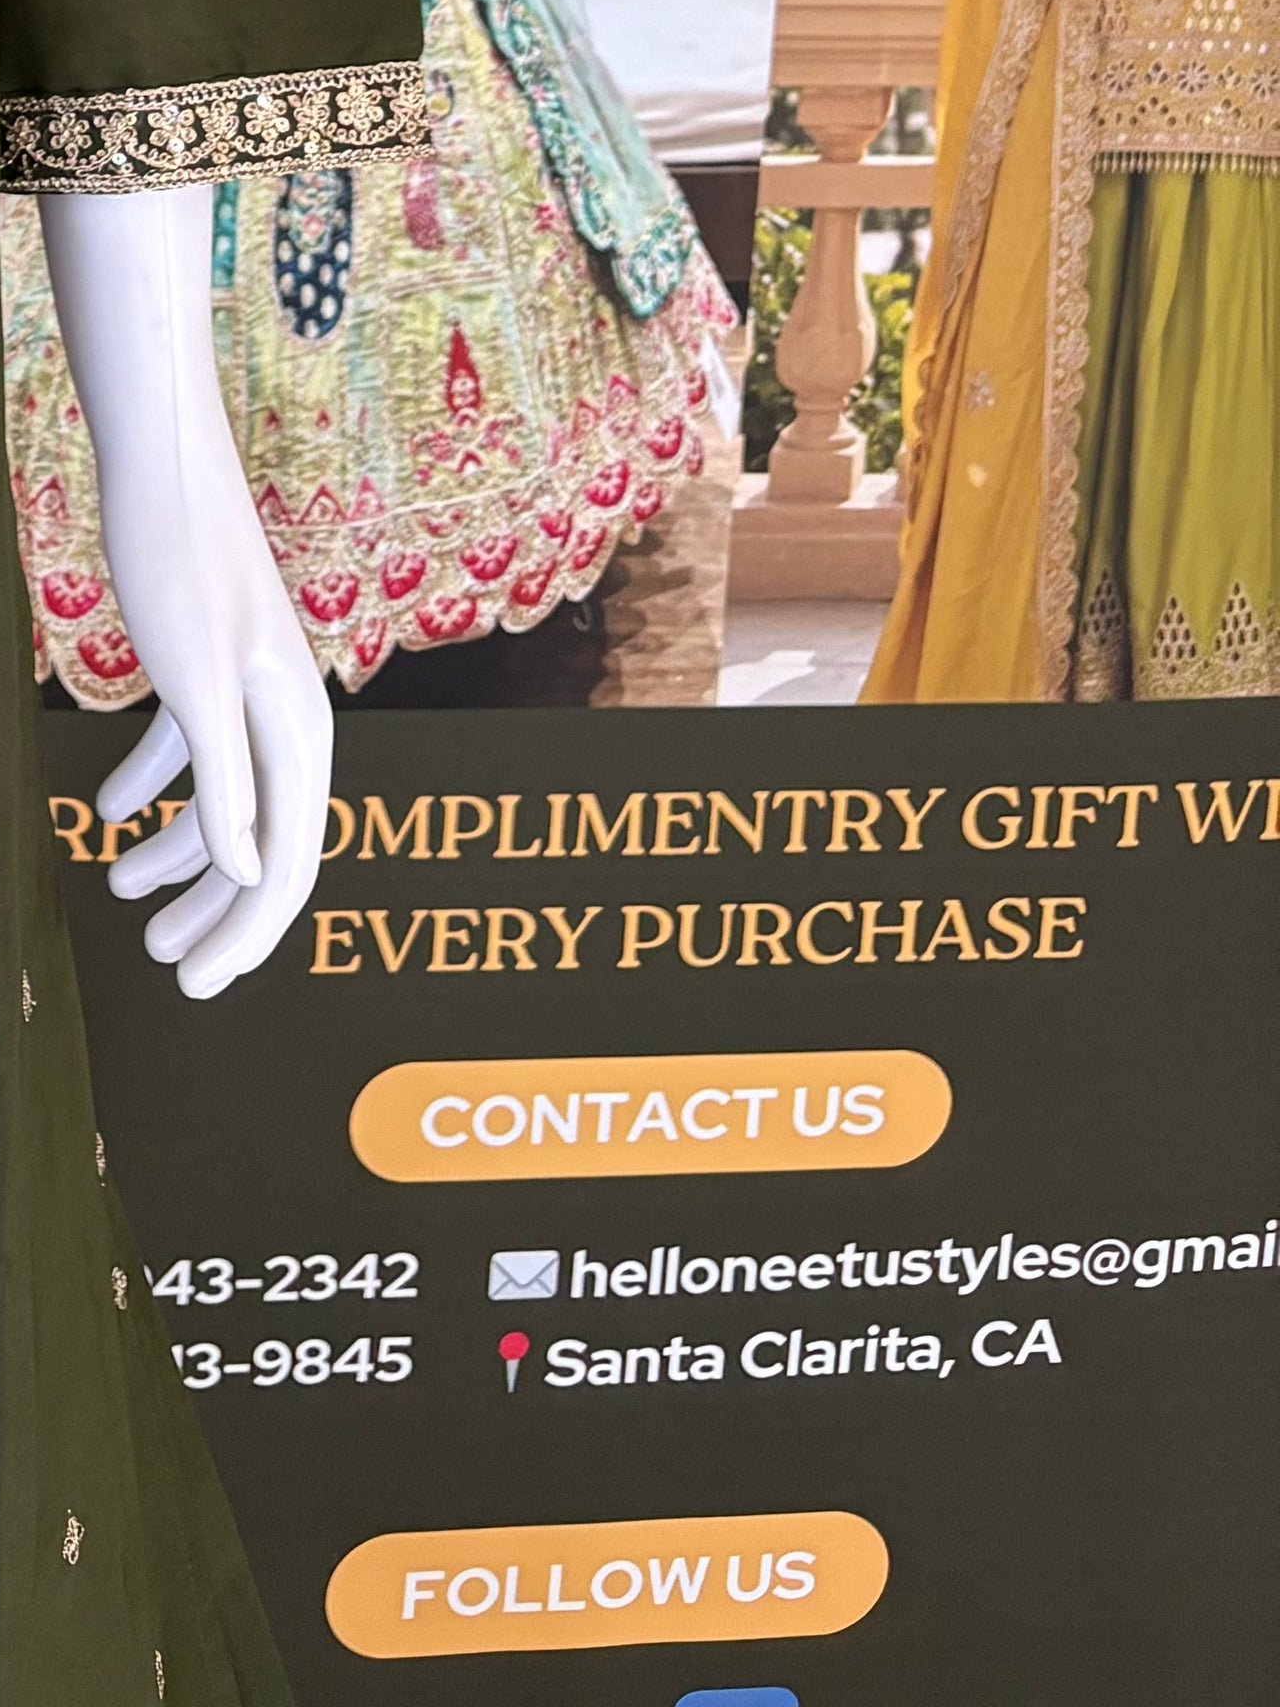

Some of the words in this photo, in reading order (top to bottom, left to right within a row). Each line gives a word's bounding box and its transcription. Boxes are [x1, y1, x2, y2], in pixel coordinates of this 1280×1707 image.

[320, 788, 946, 861] OMPLIMENTRY
[960, 782, 1159, 850] GIFT
[309, 906, 603, 975] EVERY
[616, 896, 1088, 970] PURCHASE
[420, 1087, 780, 1149] CONTACT
[792, 1083, 886, 1139] US
[143, 1251, 421, 1306] 43-2342
[570, 1219, 1280, 1303] helloneetustyles@gmai
[170, 1336, 414, 1389] 3-9845
[543, 1335, 726, 1388] Santa
[739, 1323, 956, 1379] Clarita,
[970, 1318, 1063, 1367] CA
[401, 1555, 712, 1621] FOLLOW
[725, 1550, 817, 1604] US
